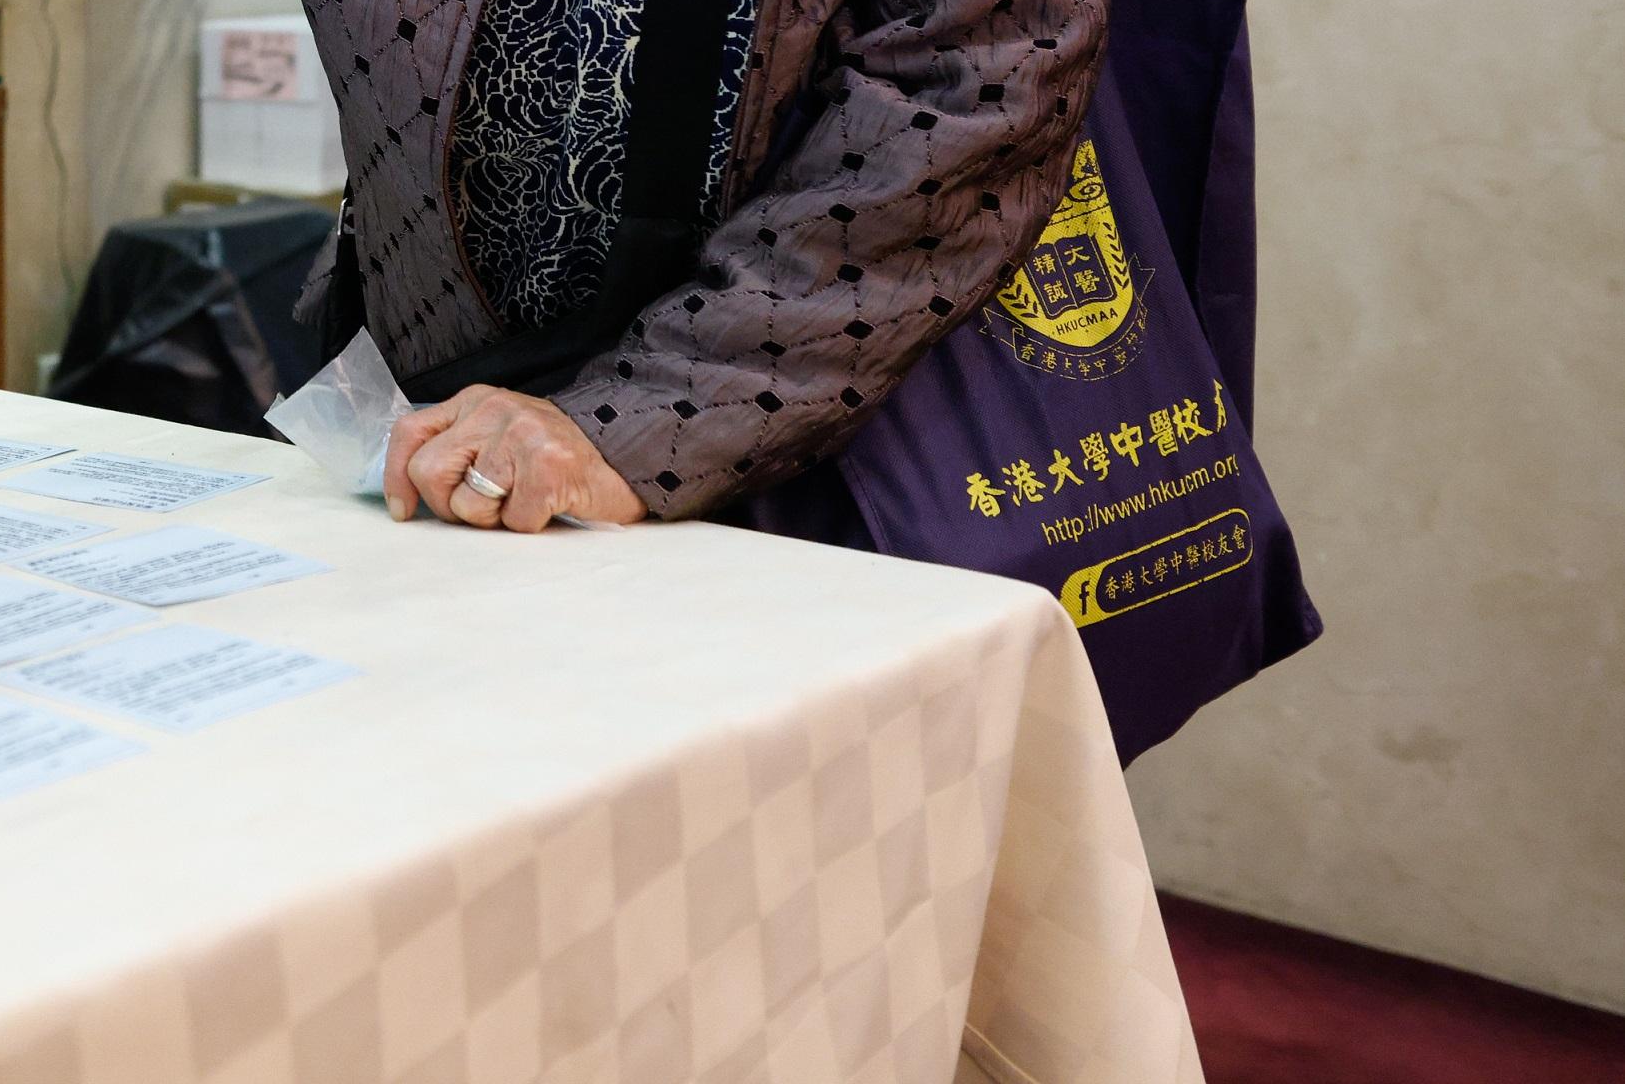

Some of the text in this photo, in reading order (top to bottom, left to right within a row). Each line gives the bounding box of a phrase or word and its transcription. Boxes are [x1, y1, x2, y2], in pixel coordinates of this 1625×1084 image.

[1031, 252, 1069, 305] 精誠
[1063, 243, 1101, 295] 大醫
[1055, 306, 1119, 336] HKUCMAA
[1104, 524, 1247, 600] 香港大學中醫校友會
